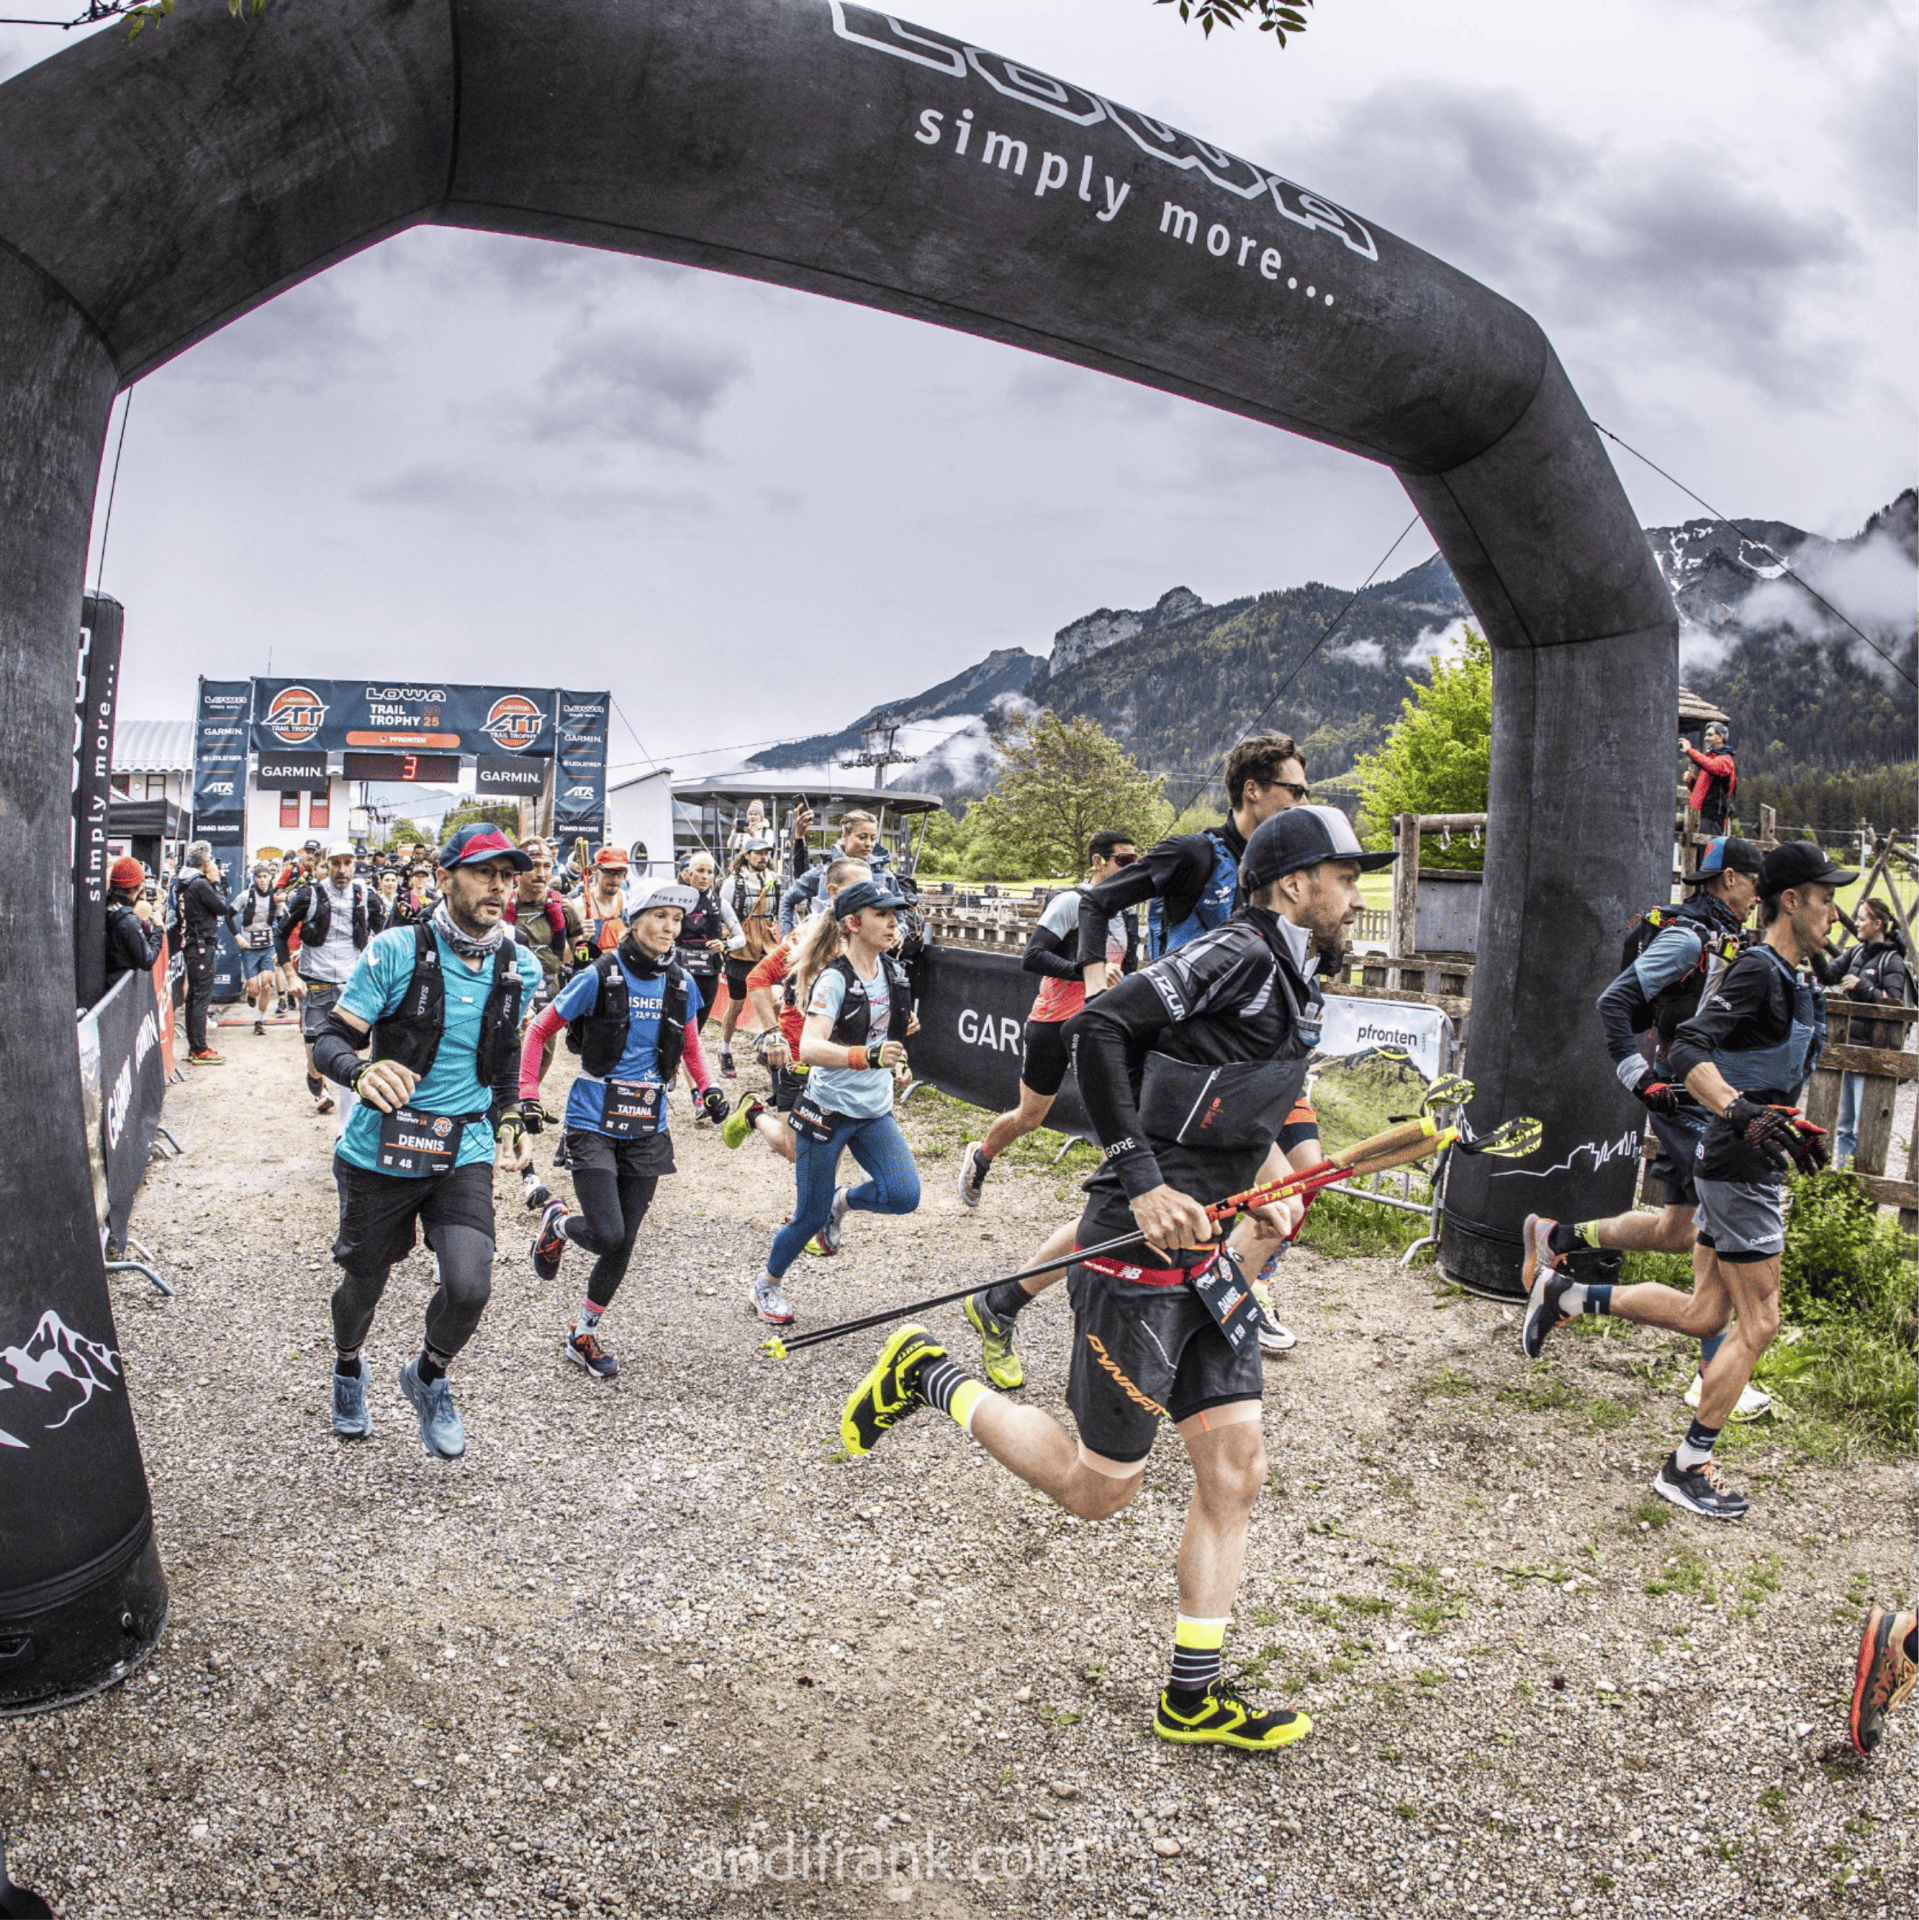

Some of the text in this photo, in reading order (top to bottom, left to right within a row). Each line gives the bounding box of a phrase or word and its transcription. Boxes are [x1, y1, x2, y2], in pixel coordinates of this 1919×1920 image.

[914, 107, 1335, 306] simply more...
[365, 687, 447, 702] LOWA
[369, 703, 406, 715] TRAIL
[369, 714, 440, 727] TROPHY 25
[402, 755, 418, 780] 3
[88, 663, 116, 902] simply more...
[650, 892, 675, 903] NIKE
[957, 1008, 1027, 1057] GAR
[1356, 1023, 1418, 1046] pfronten
[617, 1104, 652, 1116] TATIANA
[800, 1106, 823, 1125] SONJA
[618, 1122, 630, 1130] 47
[398, 1133, 445, 1152] DENNIS
[1105, 1137, 1136, 1158] GORE
[398, 1158, 413, 1169] 48
[1217, 1286, 1242, 1316] DANIEL
